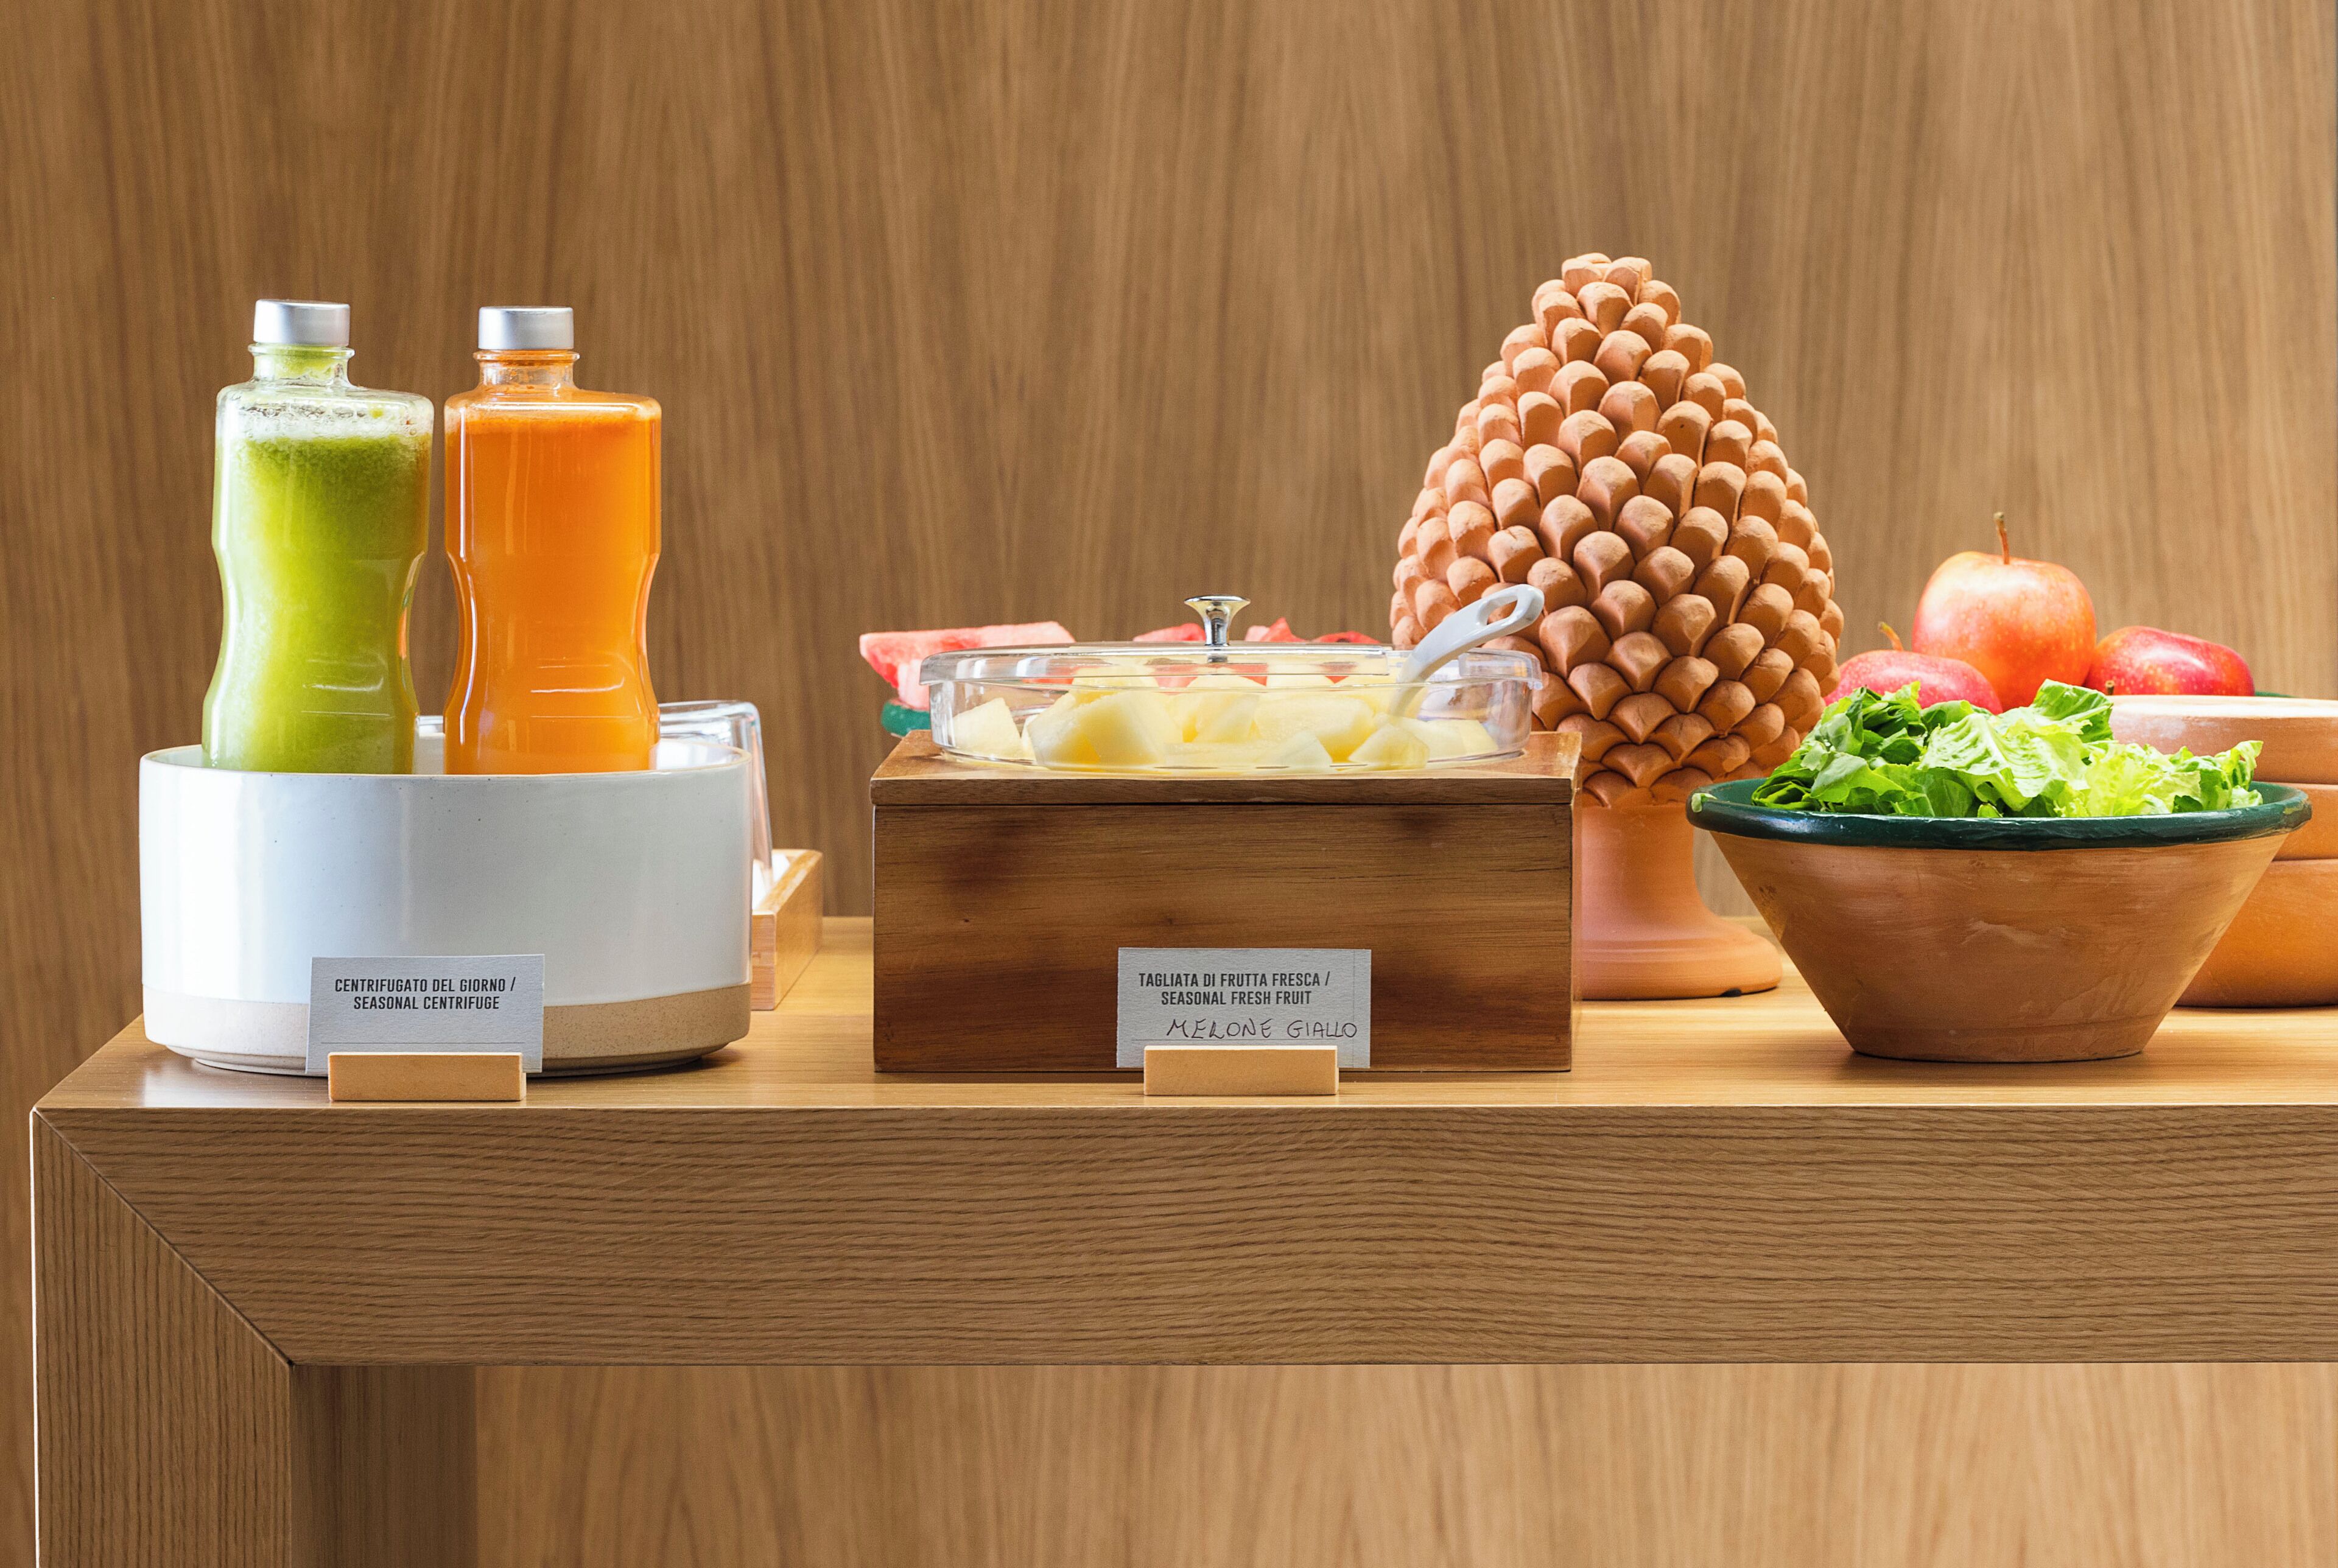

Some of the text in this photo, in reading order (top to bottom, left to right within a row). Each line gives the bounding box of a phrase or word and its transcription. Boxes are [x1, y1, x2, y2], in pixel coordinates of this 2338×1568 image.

[335, 977, 516, 992] CENTRIFUGATO DEL GIORNO /
[1139, 971, 1330, 987] TAGLIATA DI FRUTTA FRESCA /
[354, 996, 500, 1009] SEASONAL CENTRIFUGE
[1161, 991, 1311, 1005] SEASONAL FRESH FRUIT
[1287, 1020, 1357, 1038] GIALLO
